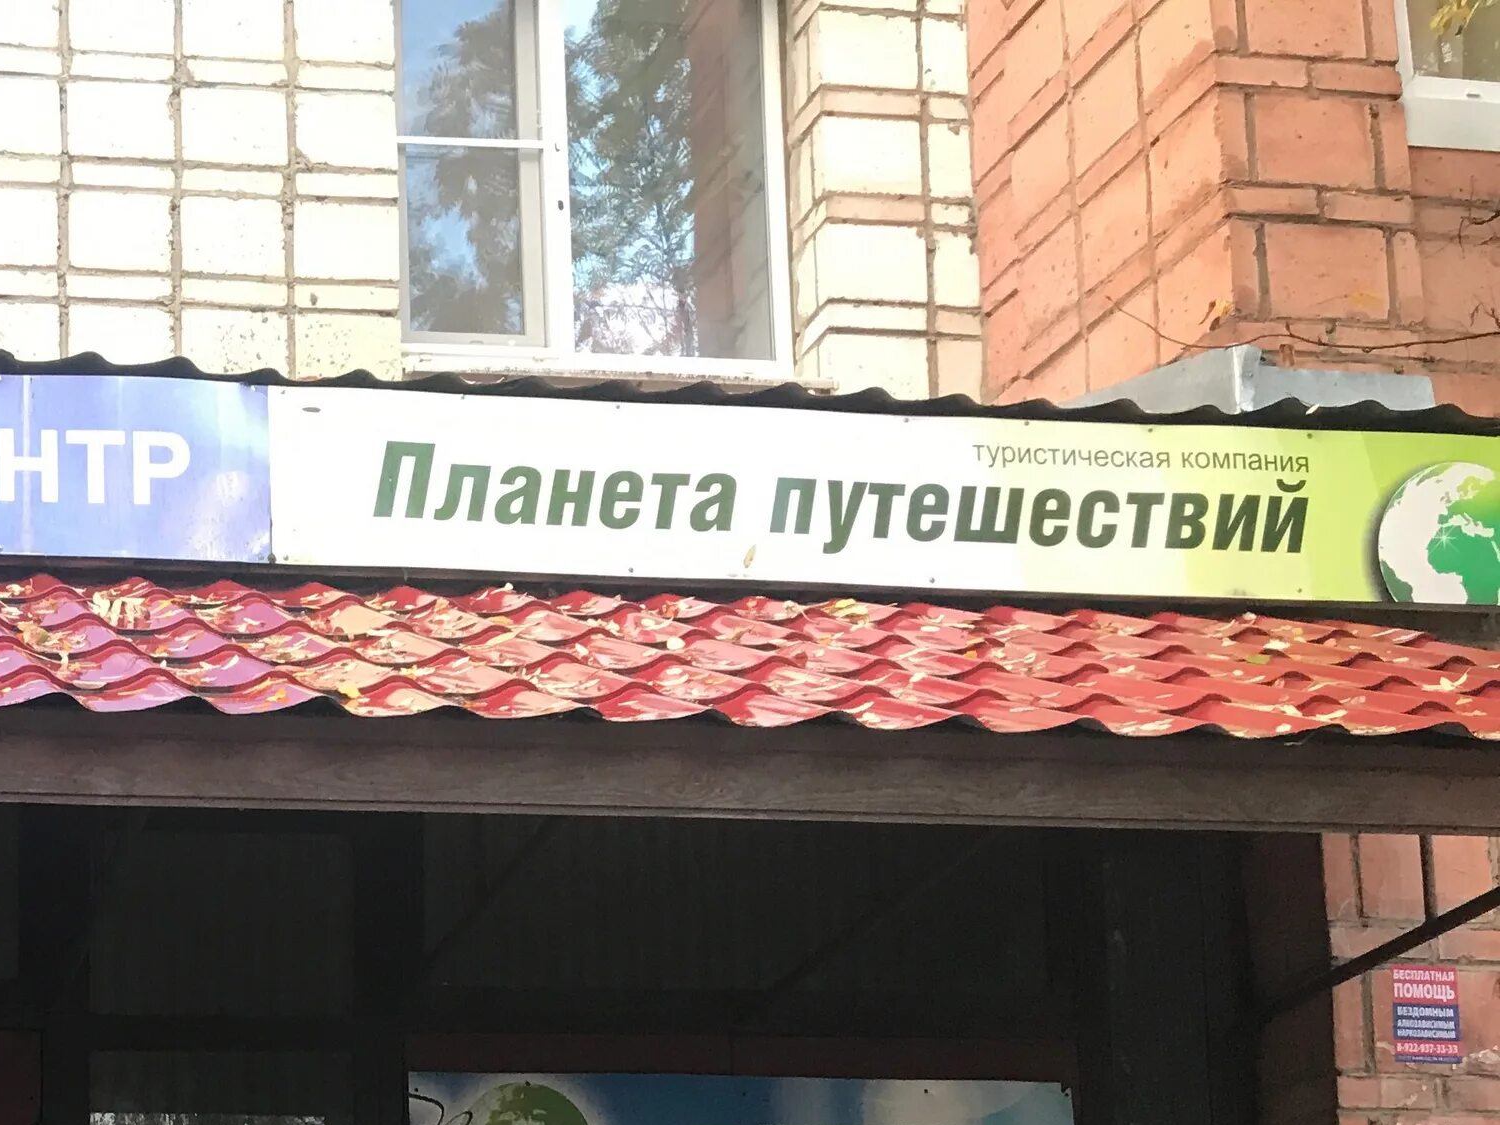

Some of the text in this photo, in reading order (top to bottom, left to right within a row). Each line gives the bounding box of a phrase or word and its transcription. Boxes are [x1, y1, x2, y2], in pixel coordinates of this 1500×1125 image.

[972, 443, 1310, 473] туристическая компания
[373, 440, 1310, 555] Планета путешествий
[1393, 969, 1454, 981] БЕСПЛАТНАЯ
[1394, 983, 1455, 1002] ПОМОЩЬ
[1397, 1006, 1454, 1017] БЕЗДОМНЫМ
